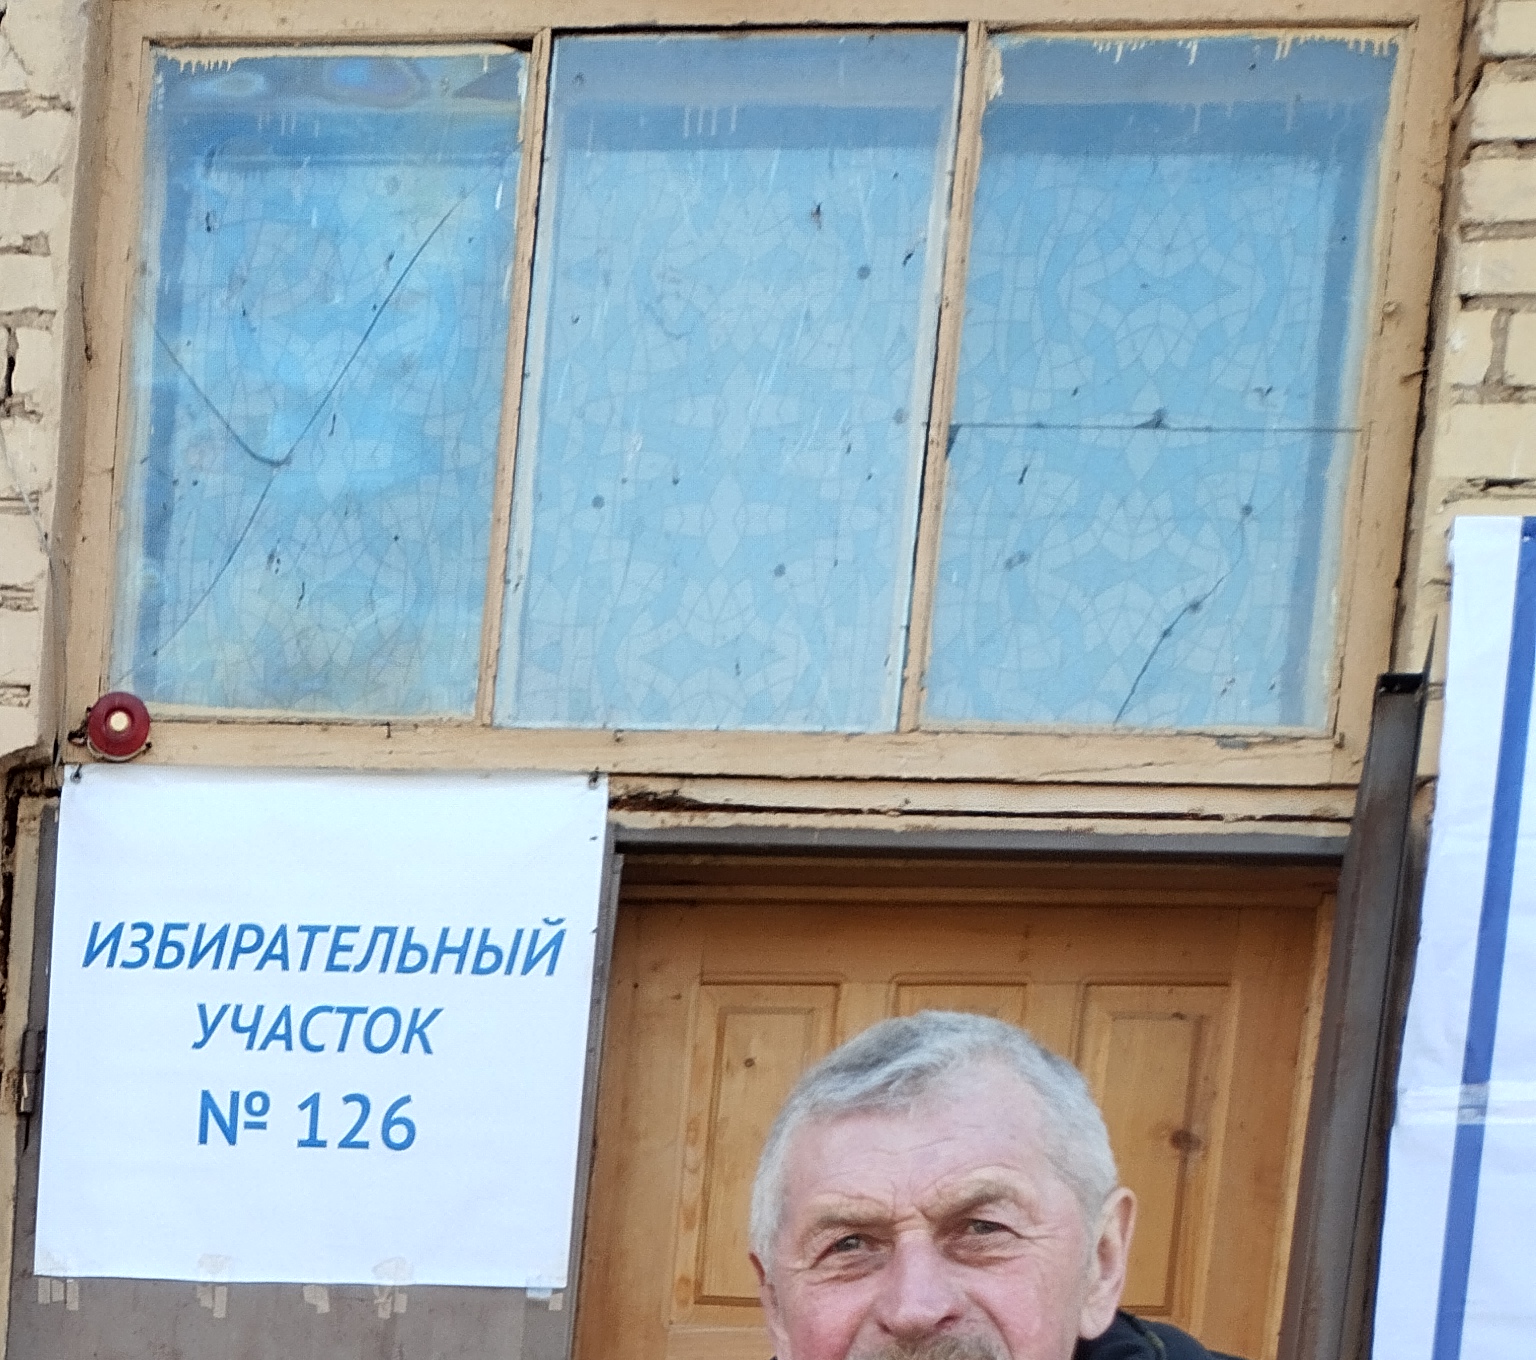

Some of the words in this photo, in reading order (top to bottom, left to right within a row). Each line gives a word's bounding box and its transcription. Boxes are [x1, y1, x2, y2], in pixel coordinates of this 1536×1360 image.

[82, 917, 567, 976] ИЗБИРАТЕЛЬНЫЙ
[192, 1003, 444, 1055] УЧАСТОК
[198, 1090, 271, 1146] №
[297, 1092, 417, 1151] 126
